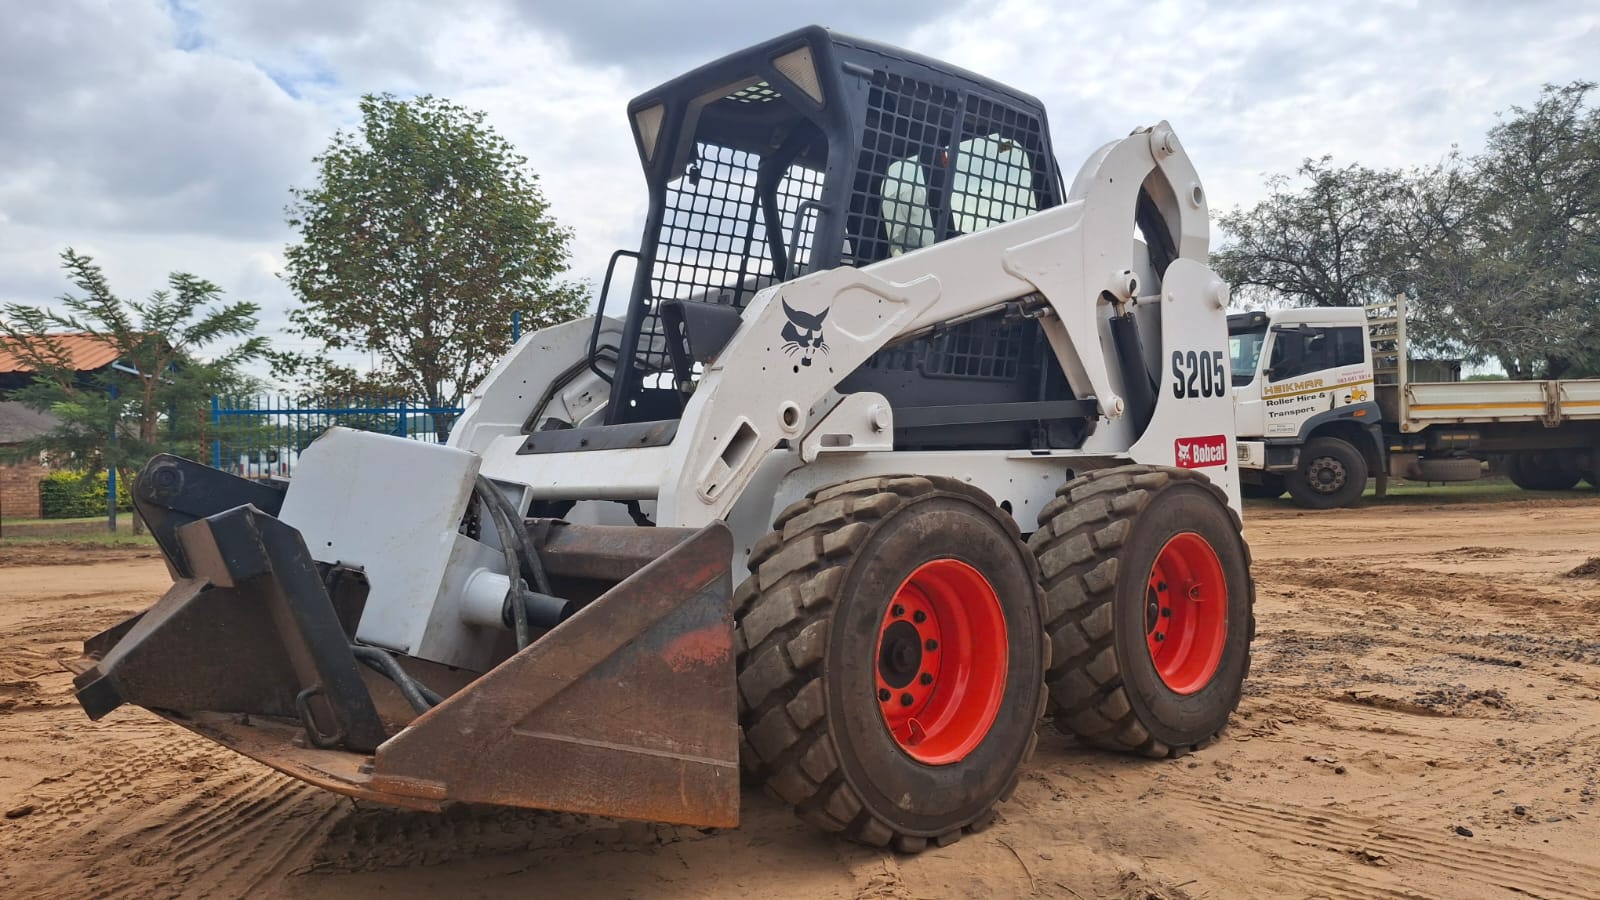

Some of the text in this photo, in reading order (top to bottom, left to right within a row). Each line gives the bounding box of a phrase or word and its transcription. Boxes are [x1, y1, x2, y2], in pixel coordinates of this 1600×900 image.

[1172, 350, 1225, 399] S205
[1264, 379, 1324, 395] HEIKMAR
[1266, 397, 1294, 407] Roller
[1297, 393, 1317, 402] Hire
[1268, 406, 1316, 418] Transport
[1193, 442, 1225, 463] Bobcat
